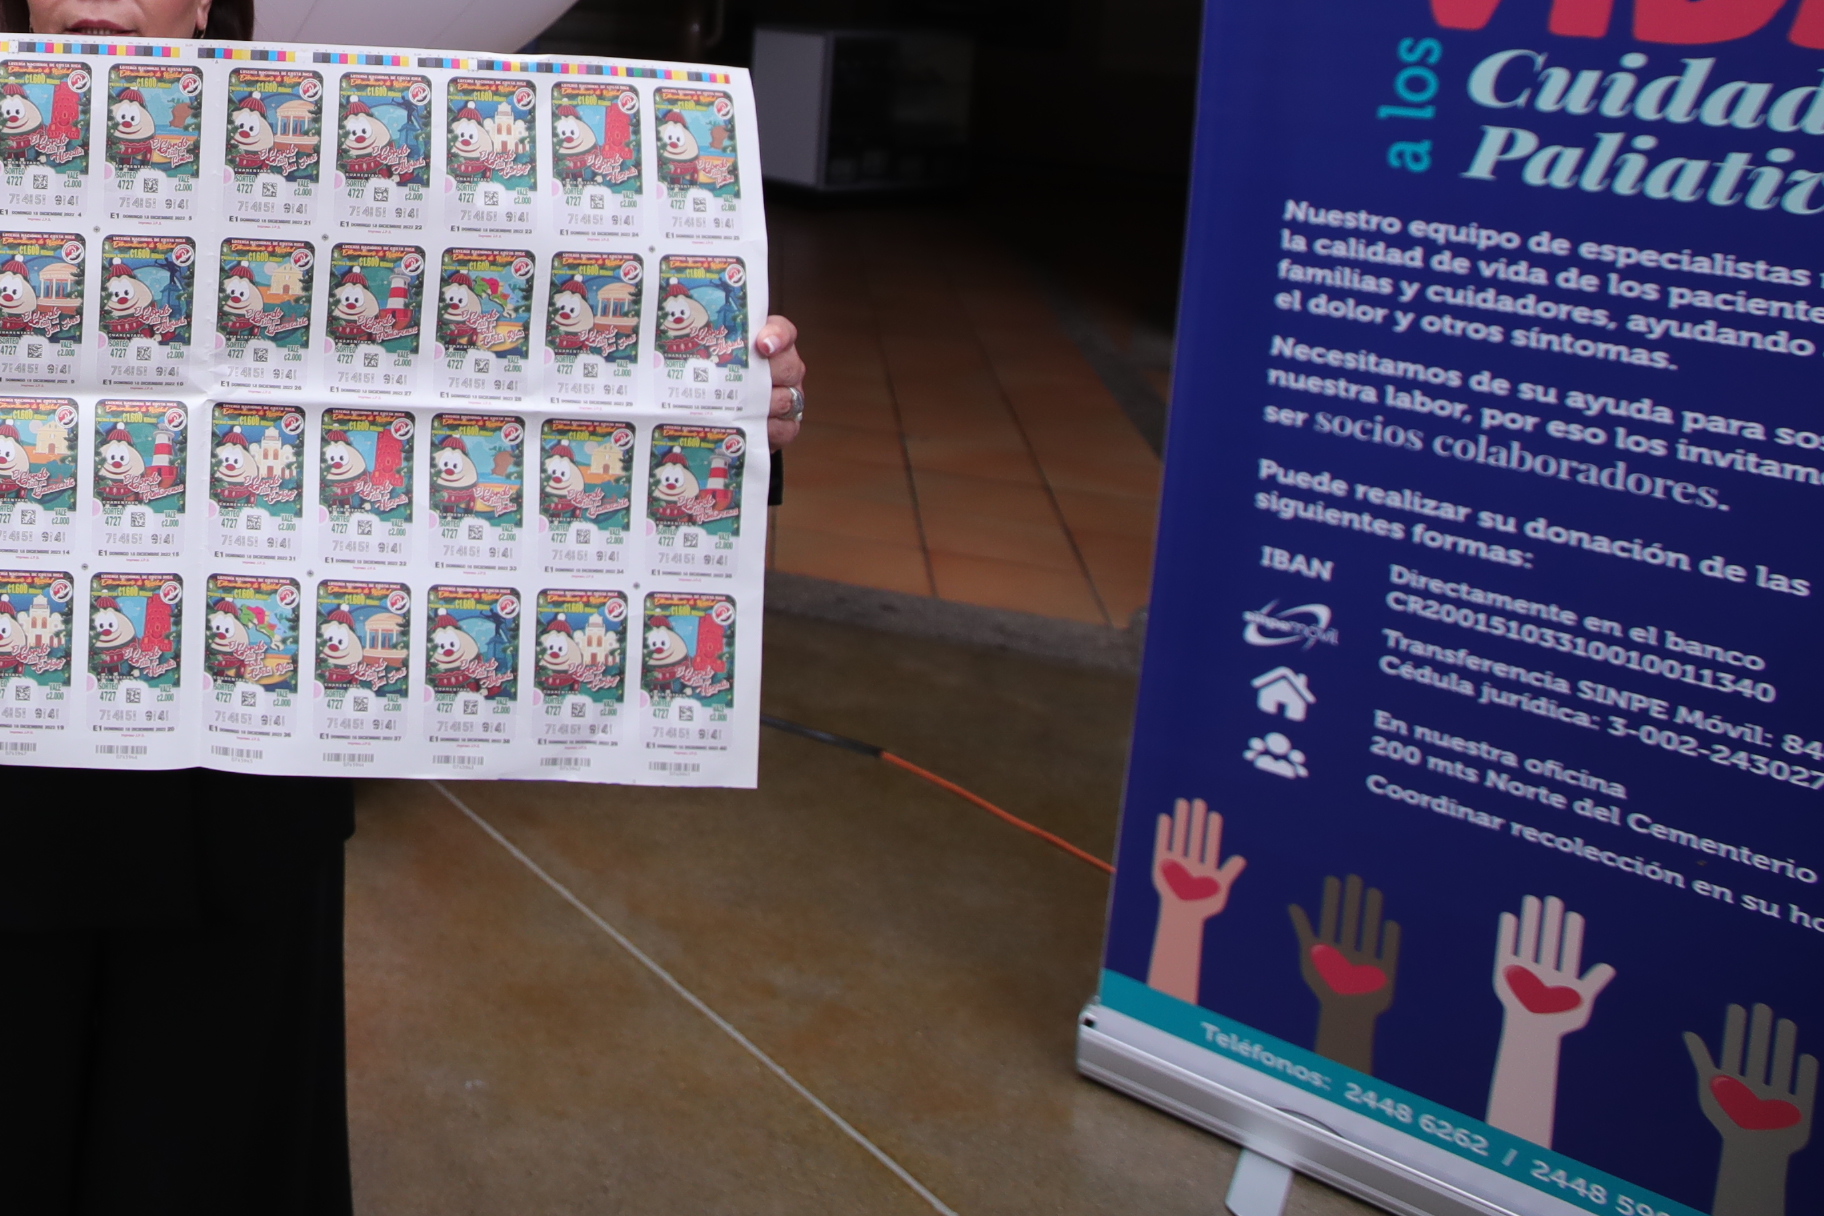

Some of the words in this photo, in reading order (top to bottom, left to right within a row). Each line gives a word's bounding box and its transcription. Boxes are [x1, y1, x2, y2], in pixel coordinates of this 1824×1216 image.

[1378, 36, 1443, 119] los
[115, 170, 137, 179] SORTEO
[117, 179, 134, 190] 4727
[345, 179, 367, 188] SORTEO
[347, 188, 364, 199] 4727
[1387, 139, 1433, 174] a
[1281, 228, 1309, 253] la
[1314, 237, 1425, 269] calidad
[1430, 249, 1472, 275] de
[1478, 257, 1550, 286] vida
[1555, 266, 1601, 293] de
[1608, 272, 1661, 301] los
[1284, 199, 1403, 235] Nuestro
[1408, 219, 1522, 251] equipo
[1528, 230, 1573, 257] de
[1578, 241, 1812, 287] especialistas
[1275, 289, 1303, 312] el
[1307, 293, 1390, 324] dolor
[1394, 310, 1417, 333] y
[1420, 314, 1505, 344] otros
[1511, 326, 1679, 371] síntomas.
[1278, 258, 1394, 295] familias
[1399, 280, 1422, 303] y
[1426, 284, 1618, 330] cuidadores,
[1627, 314, 1817, 357] ayudando
[0, 345, 17, 356] 4727
[1270, 334, 1463, 388] Necesitamos
[1469, 370, 1512, 397] de
[1518, 382, 1559, 405] su
[1565, 390, 1675, 425] ayuda
[1682, 410, 1767, 441] para
[1264, 405, 1310, 428] ser
[1315, 411, 1424, 451] socios
[1433, 434, 1731, 512] colaboradores.
[1268, 368, 1379, 404] nuestra
[1385, 384, 1473, 424] labor,
[1481, 407, 1542, 433] por
[1546, 420, 1609, 446] eso
[1615, 426, 1669, 457] los
[1676, 438, 1824, 486] invitam
[219, 509, 240, 518] SORTEO
[221, 518, 237, 529] 4727
[1256, 490, 1406, 540] siguientes
[1412, 523, 1534, 569] formas:
[1259, 458, 1350, 498] Puede
[1355, 483, 1473, 523] realizar
[1478, 510, 1518, 534] su
[1524, 517, 1692, 572] donación
[1699, 555, 1748, 583] de
[1755, 564, 1811, 597] las
[1261, 545, 1335, 582] IBAN
[1390, 564, 1579, 627] Directamente
[1583, 616, 1624, 638] en
[1629, 625, 1659, 647] el
[1664, 630, 1766, 671] banco
[213, 683, 234, 692] SORTEO
[215, 692, 232, 704] 4727
[1379, 655, 1476, 697] Cédula
[1478, 681, 1601, 730] jurídica:
[1382, 628, 1572, 695] Transferencia
[1577, 680, 1670, 721] SINPE
[1673, 705, 1774, 748] Móvil:
[208, 724, 218, 732] E1
[1374, 709, 1410, 736] En
[1414, 725, 1520, 768] nuestra
[1524, 758, 1628, 800] oficina
[1366, 774, 1507, 831] Coordinar
[1510, 821, 1686, 889] recolección
[1692, 880, 1735, 905] en
[1740, 894, 1781, 919] su
[1370, 735, 1423, 766] 200
[1427, 755, 1480, 784] mts
[1484, 769, 1568, 810] Norte
[1573, 798, 1622, 826] del
[1627, 812, 1818, 884] Cementerio
[1200, 1021, 1332, 1091] Teléfonos:
[1344, 1082, 1414, 1125] 2448
[1418, 1113, 1489, 1157] 6262
[1530, 1158, 1608, 1205] 2448
[1615, 1193, 1671, 1216] 59
